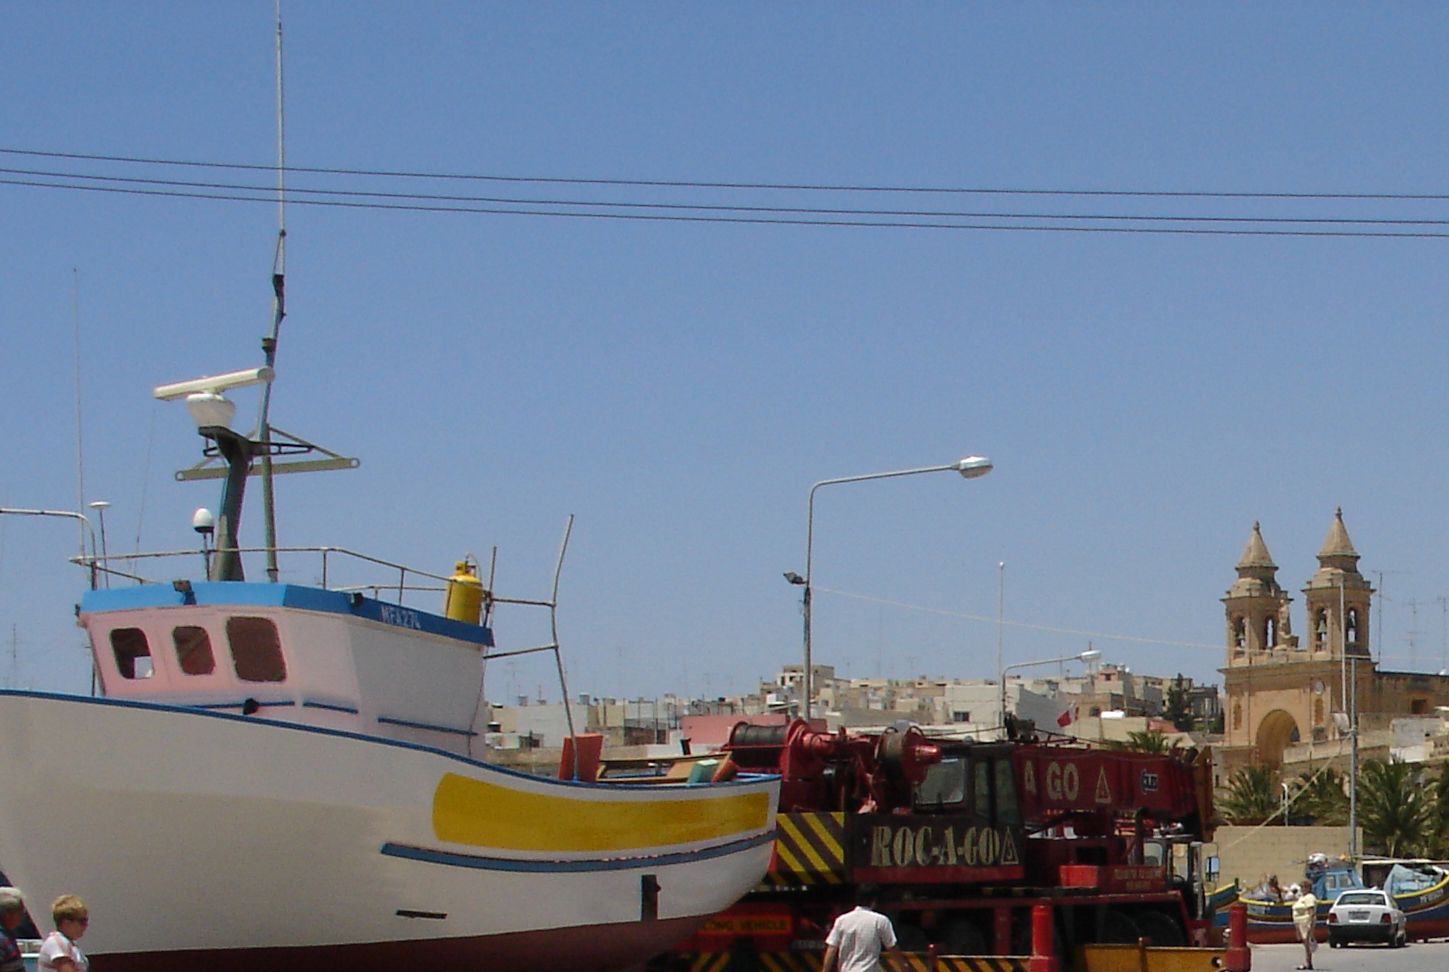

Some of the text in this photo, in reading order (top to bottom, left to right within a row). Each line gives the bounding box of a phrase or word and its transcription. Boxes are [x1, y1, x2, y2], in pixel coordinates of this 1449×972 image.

[1024, 760, 1080, 801] A GO
[870, 825, 1000, 867] ROC-A-GO
